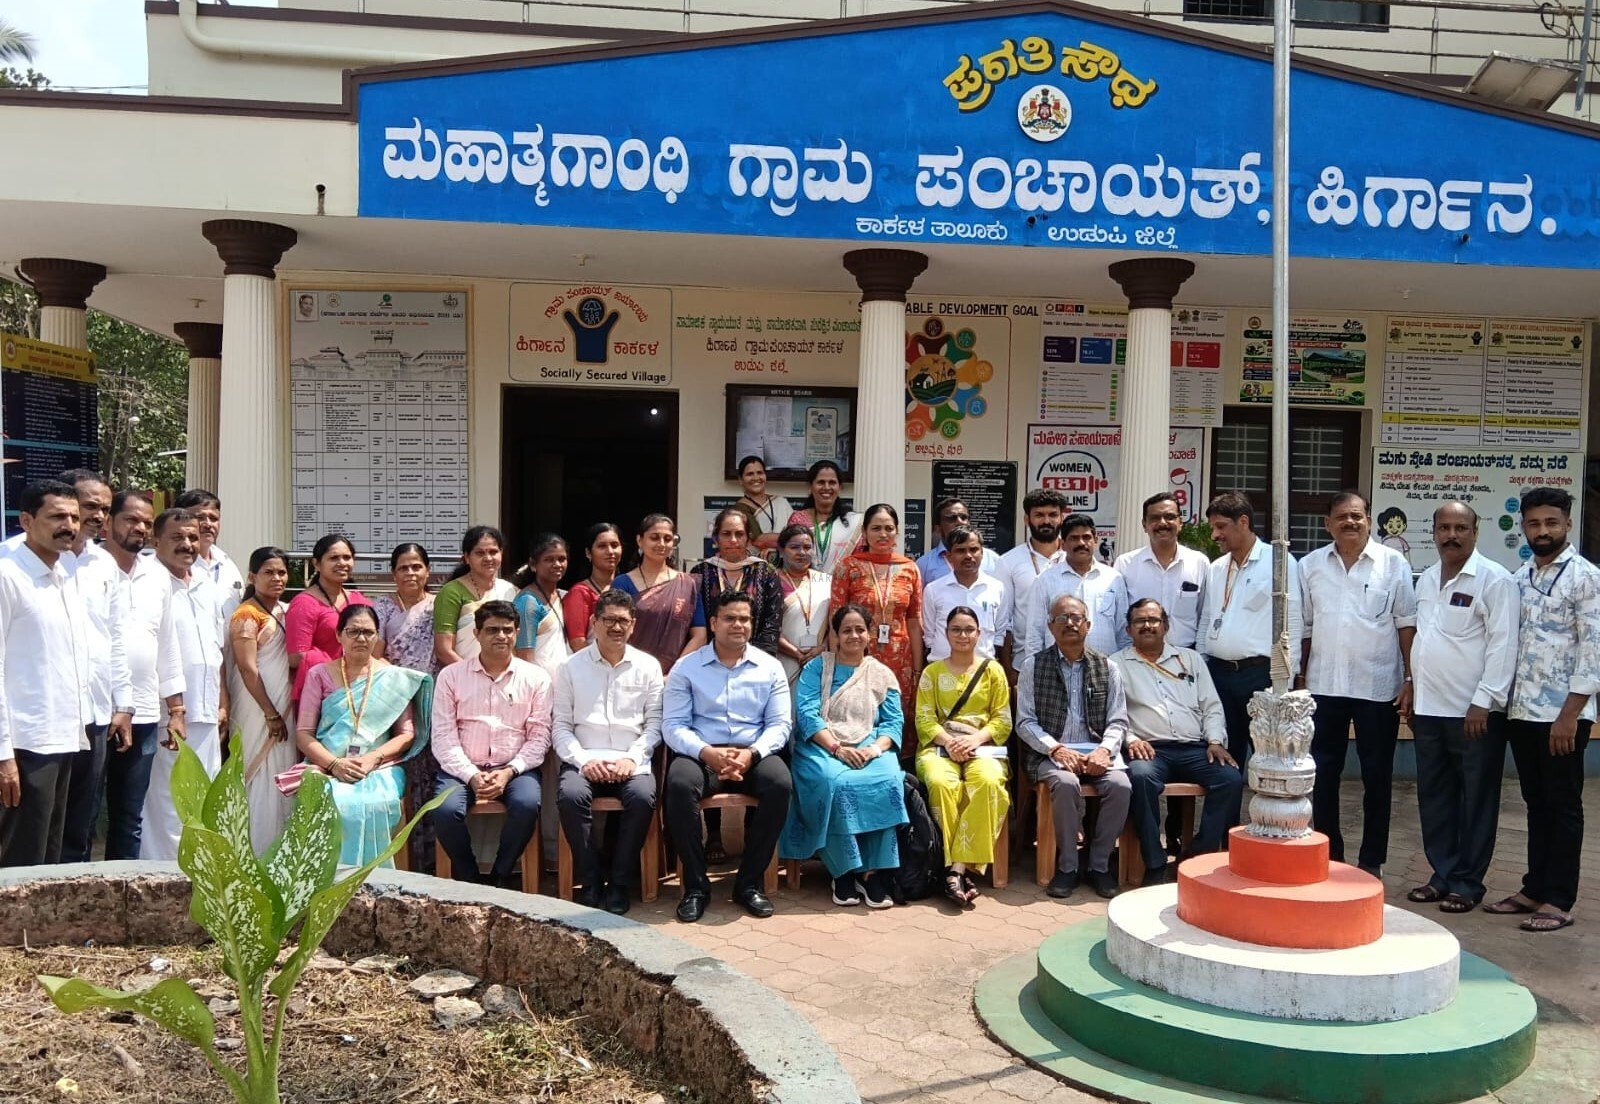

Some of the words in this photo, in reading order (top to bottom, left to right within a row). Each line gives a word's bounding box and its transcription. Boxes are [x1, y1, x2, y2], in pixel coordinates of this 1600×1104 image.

[942, 36, 1054, 112] ಪ್ರಗತಿ
[1060, 41, 1157, 109] ಸೌಧ
[382, 116, 690, 207] ಮಹಾತ್ಮಗಾಂಧಿ
[728, 138, 873, 216] ಗ್ರಾಮ
[855, 214, 926, 236] ಕಾರ್ಕಳ
[930, 220, 1009, 242] ತಾಲೂಕು
[1047, 223, 1128, 244] ಉಡುಪಿ
[1134, 226, 1179, 250] ಜಿಲ್ಲೆ
[544, 295, 565, 318] ಗ್ರಾಮ
[939, 302, 1008, 316] DEVLOPMENT
[1012, 304, 1039, 317] GOAL
[516, 335, 566, 353] ಹಿರ್ಗಾನ
[613, 340, 660, 356] ಕಾರ್ಕಳ
[540, 366, 583, 382] Socially
[586, 369, 628, 380] Secured
[631, 371, 666, 384] Village
[1033, 430, 1068, 446] ಮಹಿಳಾ
[1049, 462, 1092, 473] WOMEN
[1379, 451, 1406, 465] ಮಗು
[1409, 451, 1433, 469] ಸ್ನೇಹಿ
[1520, 455, 1545, 472] ನಮ್ಮ
[1547, 455, 1568, 470] ನಡೆ
[1046, 477, 1083, 490] 181
